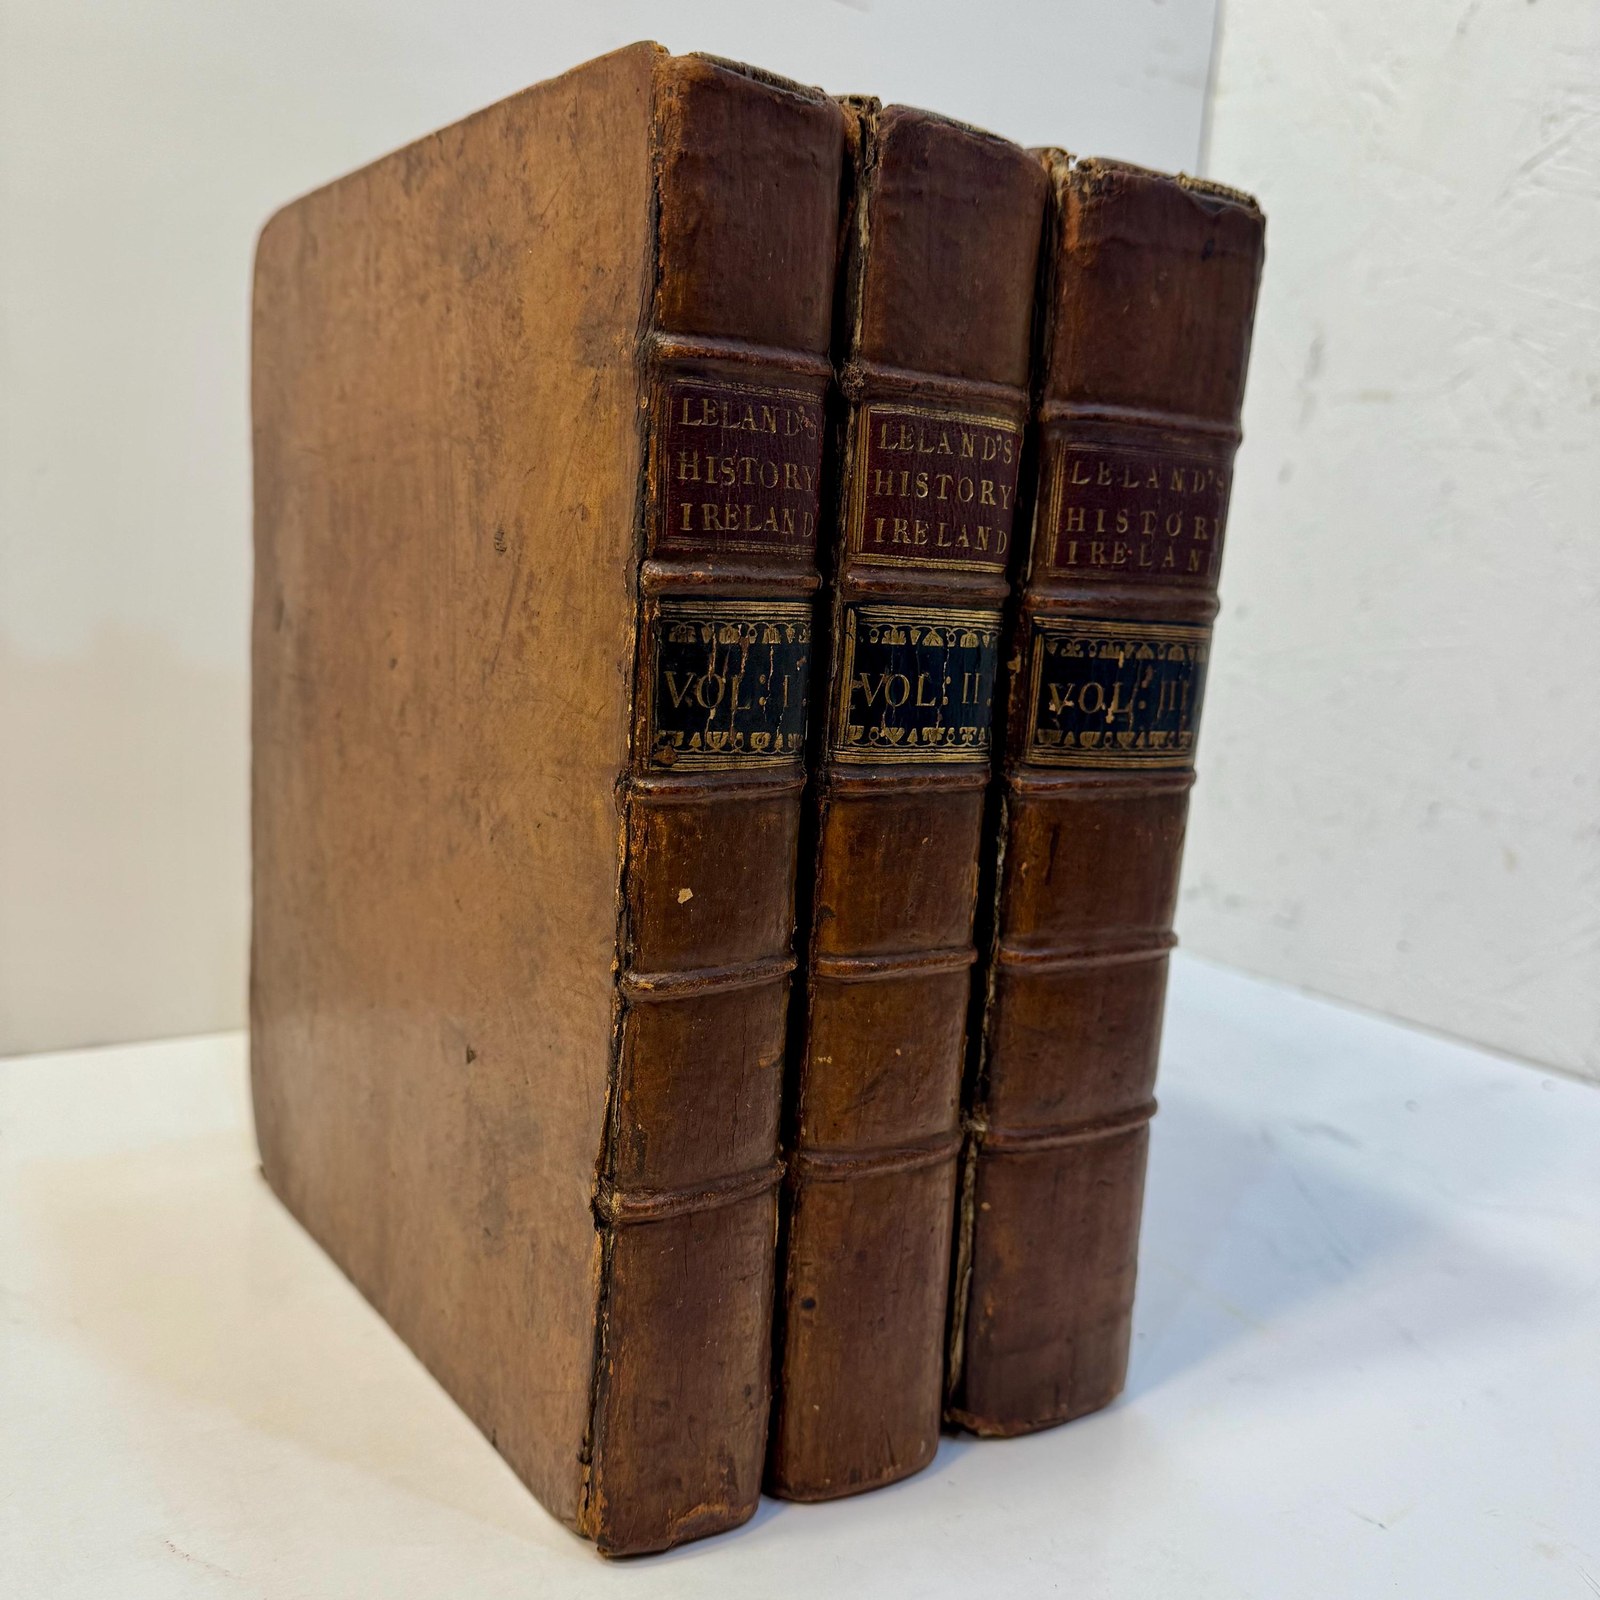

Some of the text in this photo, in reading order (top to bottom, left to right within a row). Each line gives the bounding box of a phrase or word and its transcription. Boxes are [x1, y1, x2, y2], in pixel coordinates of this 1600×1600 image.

[877, 423, 1012, 464] LELAND'S
[676, 450, 816, 492] HISTORY
[874, 469, 1012, 510] HISTORY
[679, 502, 814, 538] IRELAND
[874, 517, 1008, 555] IRELAND
[859, 672, 951, 707] VOL:
